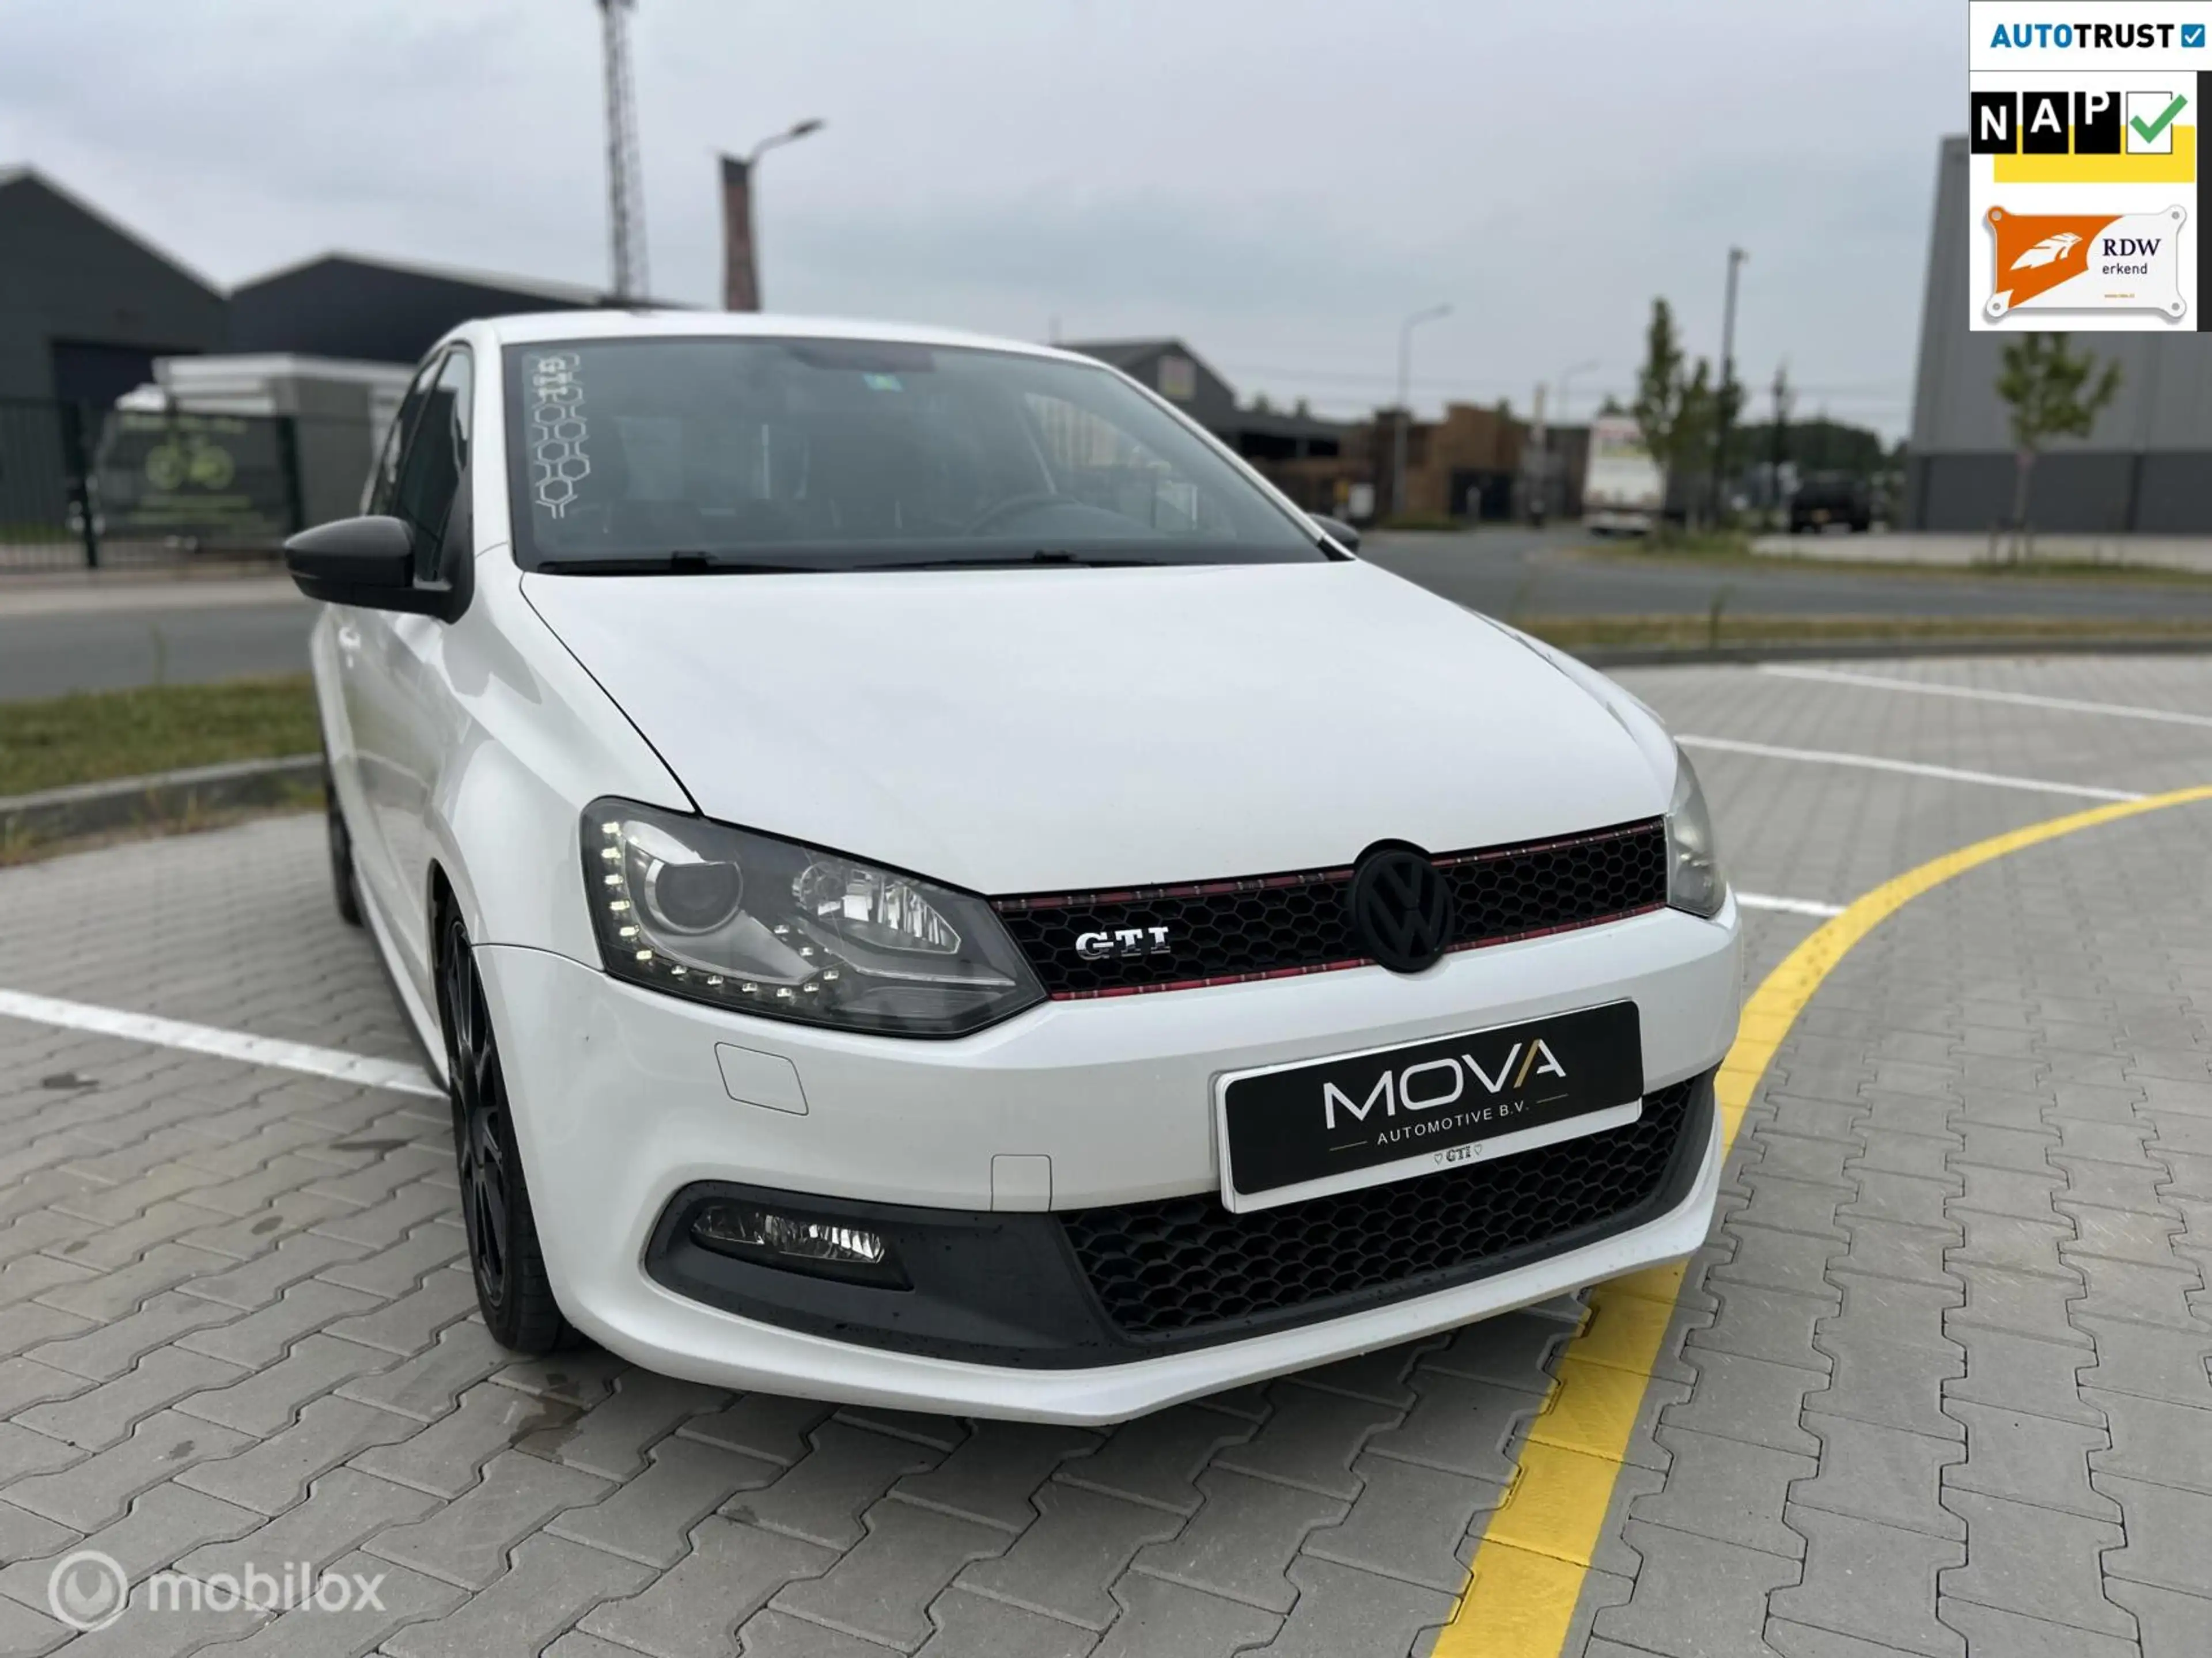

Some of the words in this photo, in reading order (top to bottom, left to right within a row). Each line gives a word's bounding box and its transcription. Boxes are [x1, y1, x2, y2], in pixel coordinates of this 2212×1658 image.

[1075, 926, 1171, 961] GTI
[1323, 1038, 1567, 1129] MOVA
[1377, 1107, 1493, 1145] AUTOMOTIVE
[1499, 1100, 1529, 1117] B.V.
